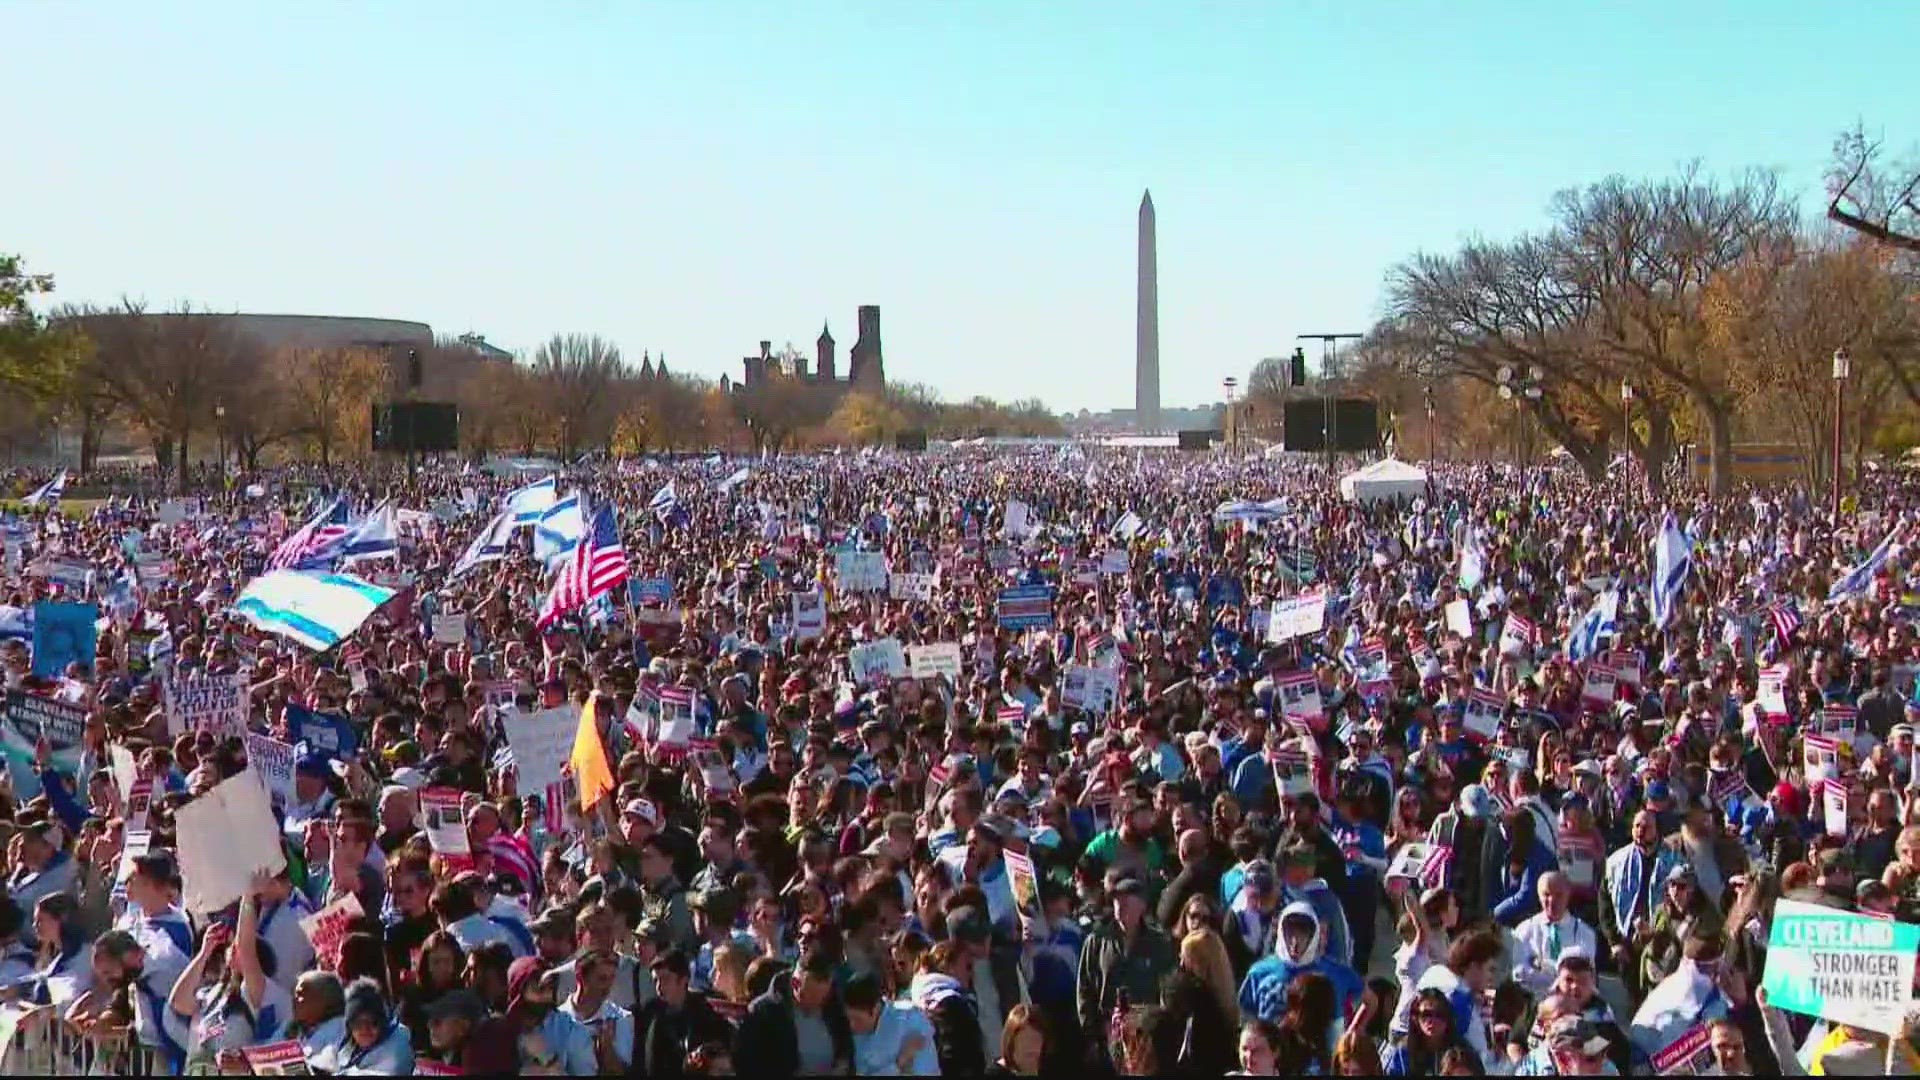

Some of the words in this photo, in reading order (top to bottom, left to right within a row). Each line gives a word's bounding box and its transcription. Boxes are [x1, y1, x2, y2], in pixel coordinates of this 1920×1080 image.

[1784, 920, 1893, 947] CLEVELAND
[1813, 952, 1899, 977] STRONGER
[1810, 977, 1854, 999] THAN
[1860, 978, 1902, 1002] HATE
